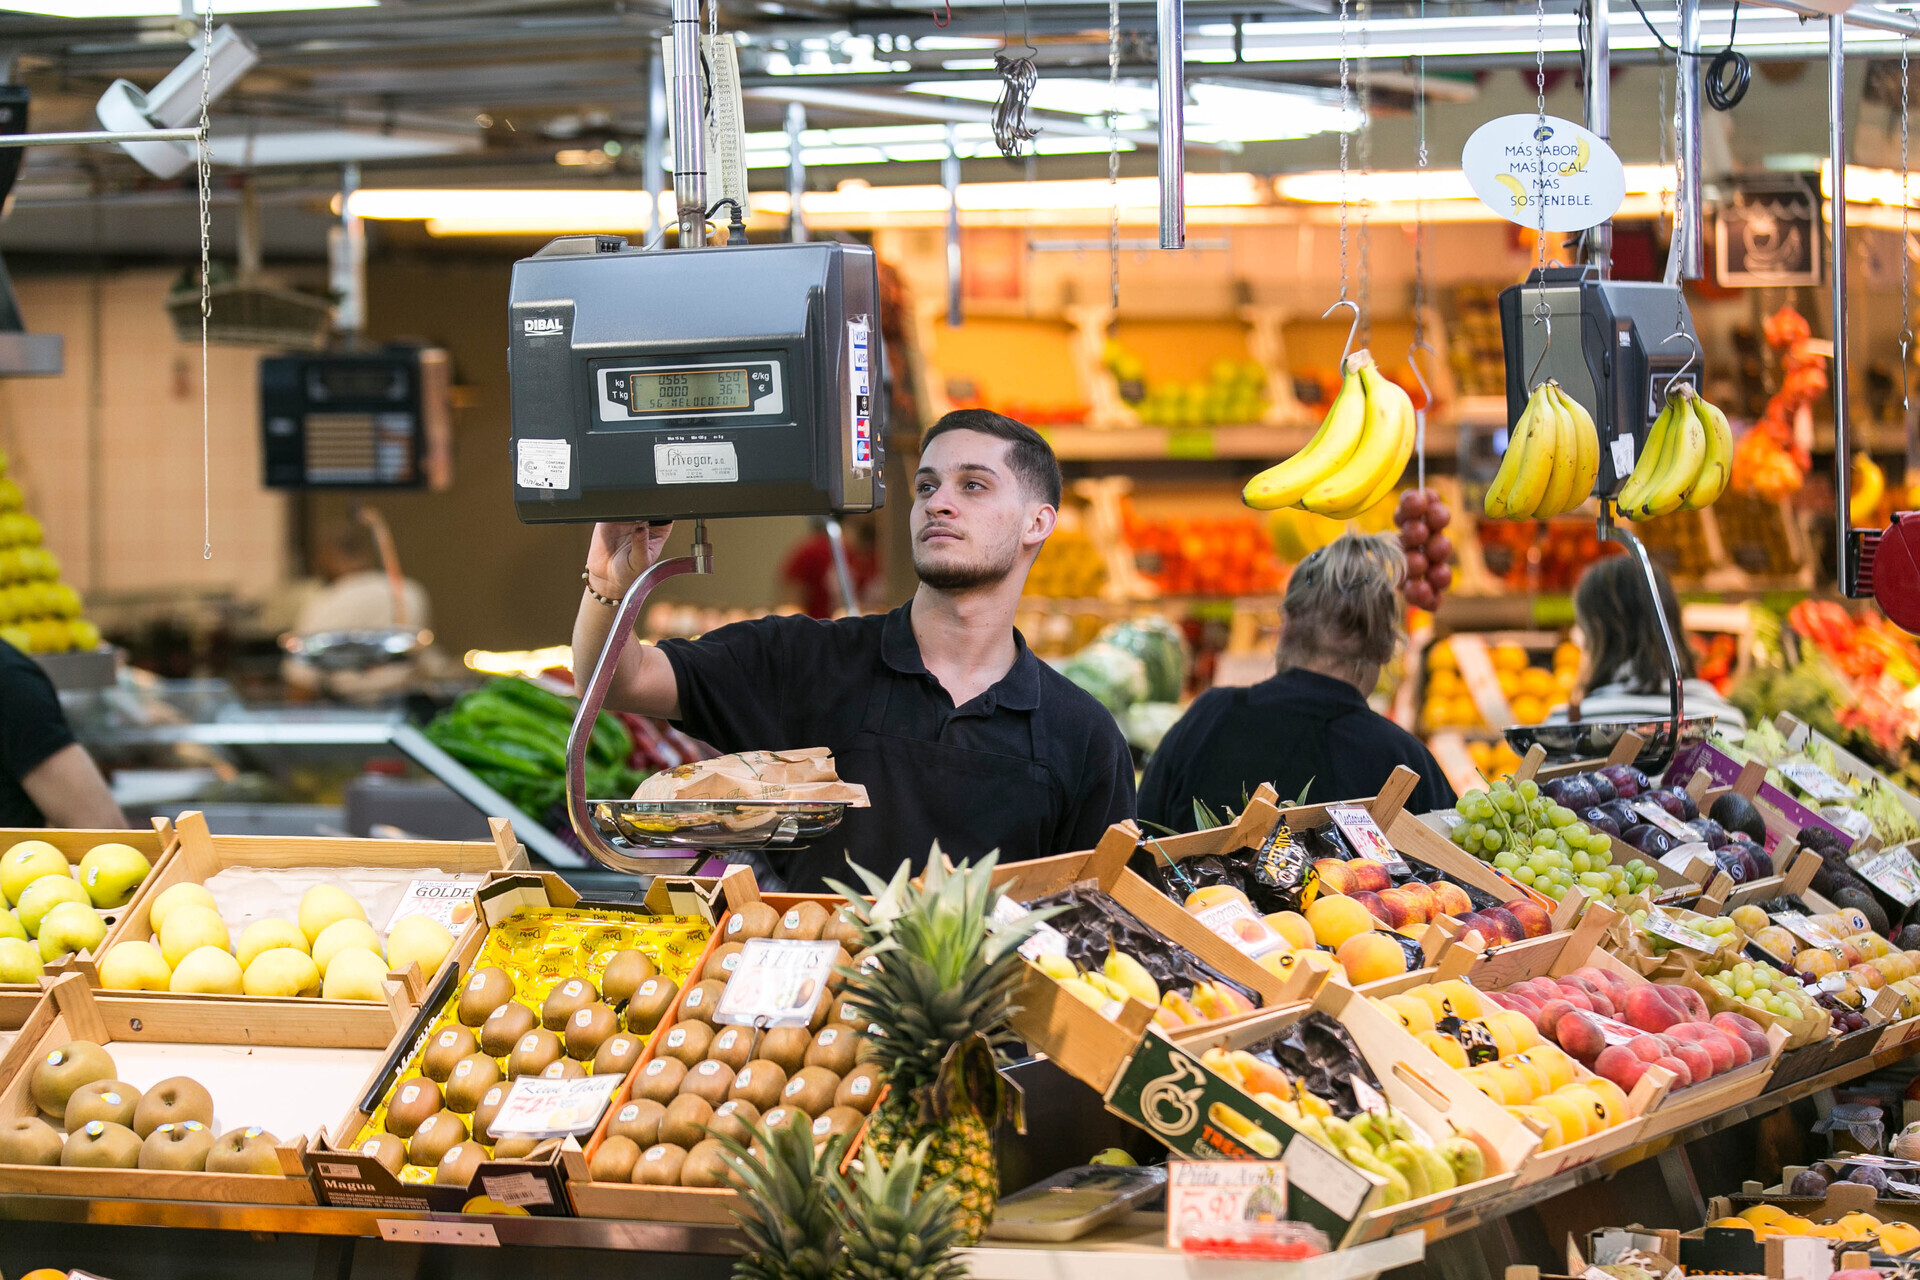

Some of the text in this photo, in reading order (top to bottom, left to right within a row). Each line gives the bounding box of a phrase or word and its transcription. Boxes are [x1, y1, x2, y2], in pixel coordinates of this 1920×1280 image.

[1505, 142, 1580, 157] MÁS SABOR,
[1509, 158, 1588, 173] MÁS LOCAL,
[1532, 175, 1560, 189] MÁS
[1510, 195, 1593, 206] SOSTENIBLE.
[524, 318, 563, 331] DIBAL
[751, 372, 770, 382] €/kg
[615, 379, 625, 389] kg
[758, 384, 766, 392] €
[612, 391, 629, 400] T kg
[416, 887, 474, 898] GOLDE
[324, 1179, 377, 1192] Magua
